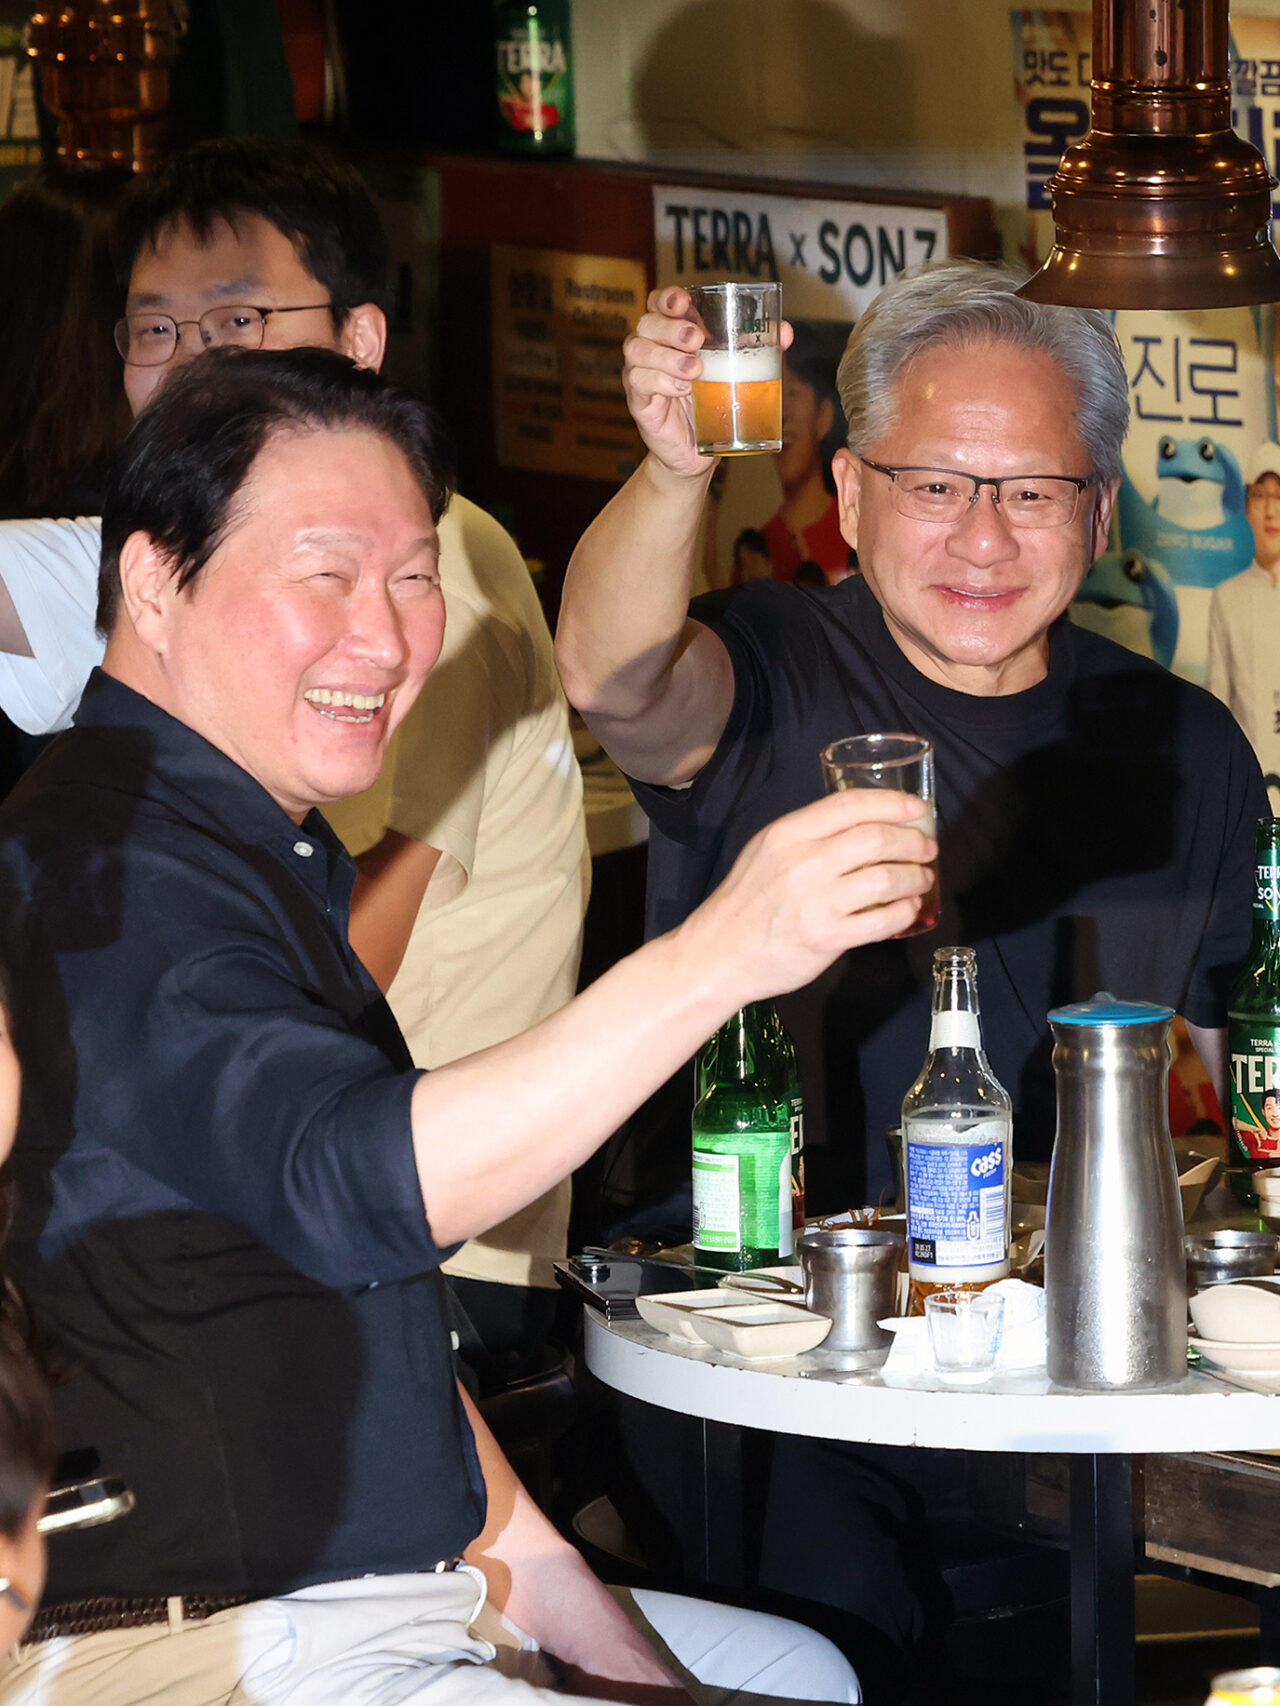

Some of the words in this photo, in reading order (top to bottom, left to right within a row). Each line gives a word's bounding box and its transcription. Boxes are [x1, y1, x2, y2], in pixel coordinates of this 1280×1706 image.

[498, 41, 567, 74] TERRA
[1024, 50, 1070, 86] 맛도
[665, 205, 779, 281] TERRA
[1132, 335, 1244, 427] 진로
[1250, 1038, 1273, 1047] TERRA
